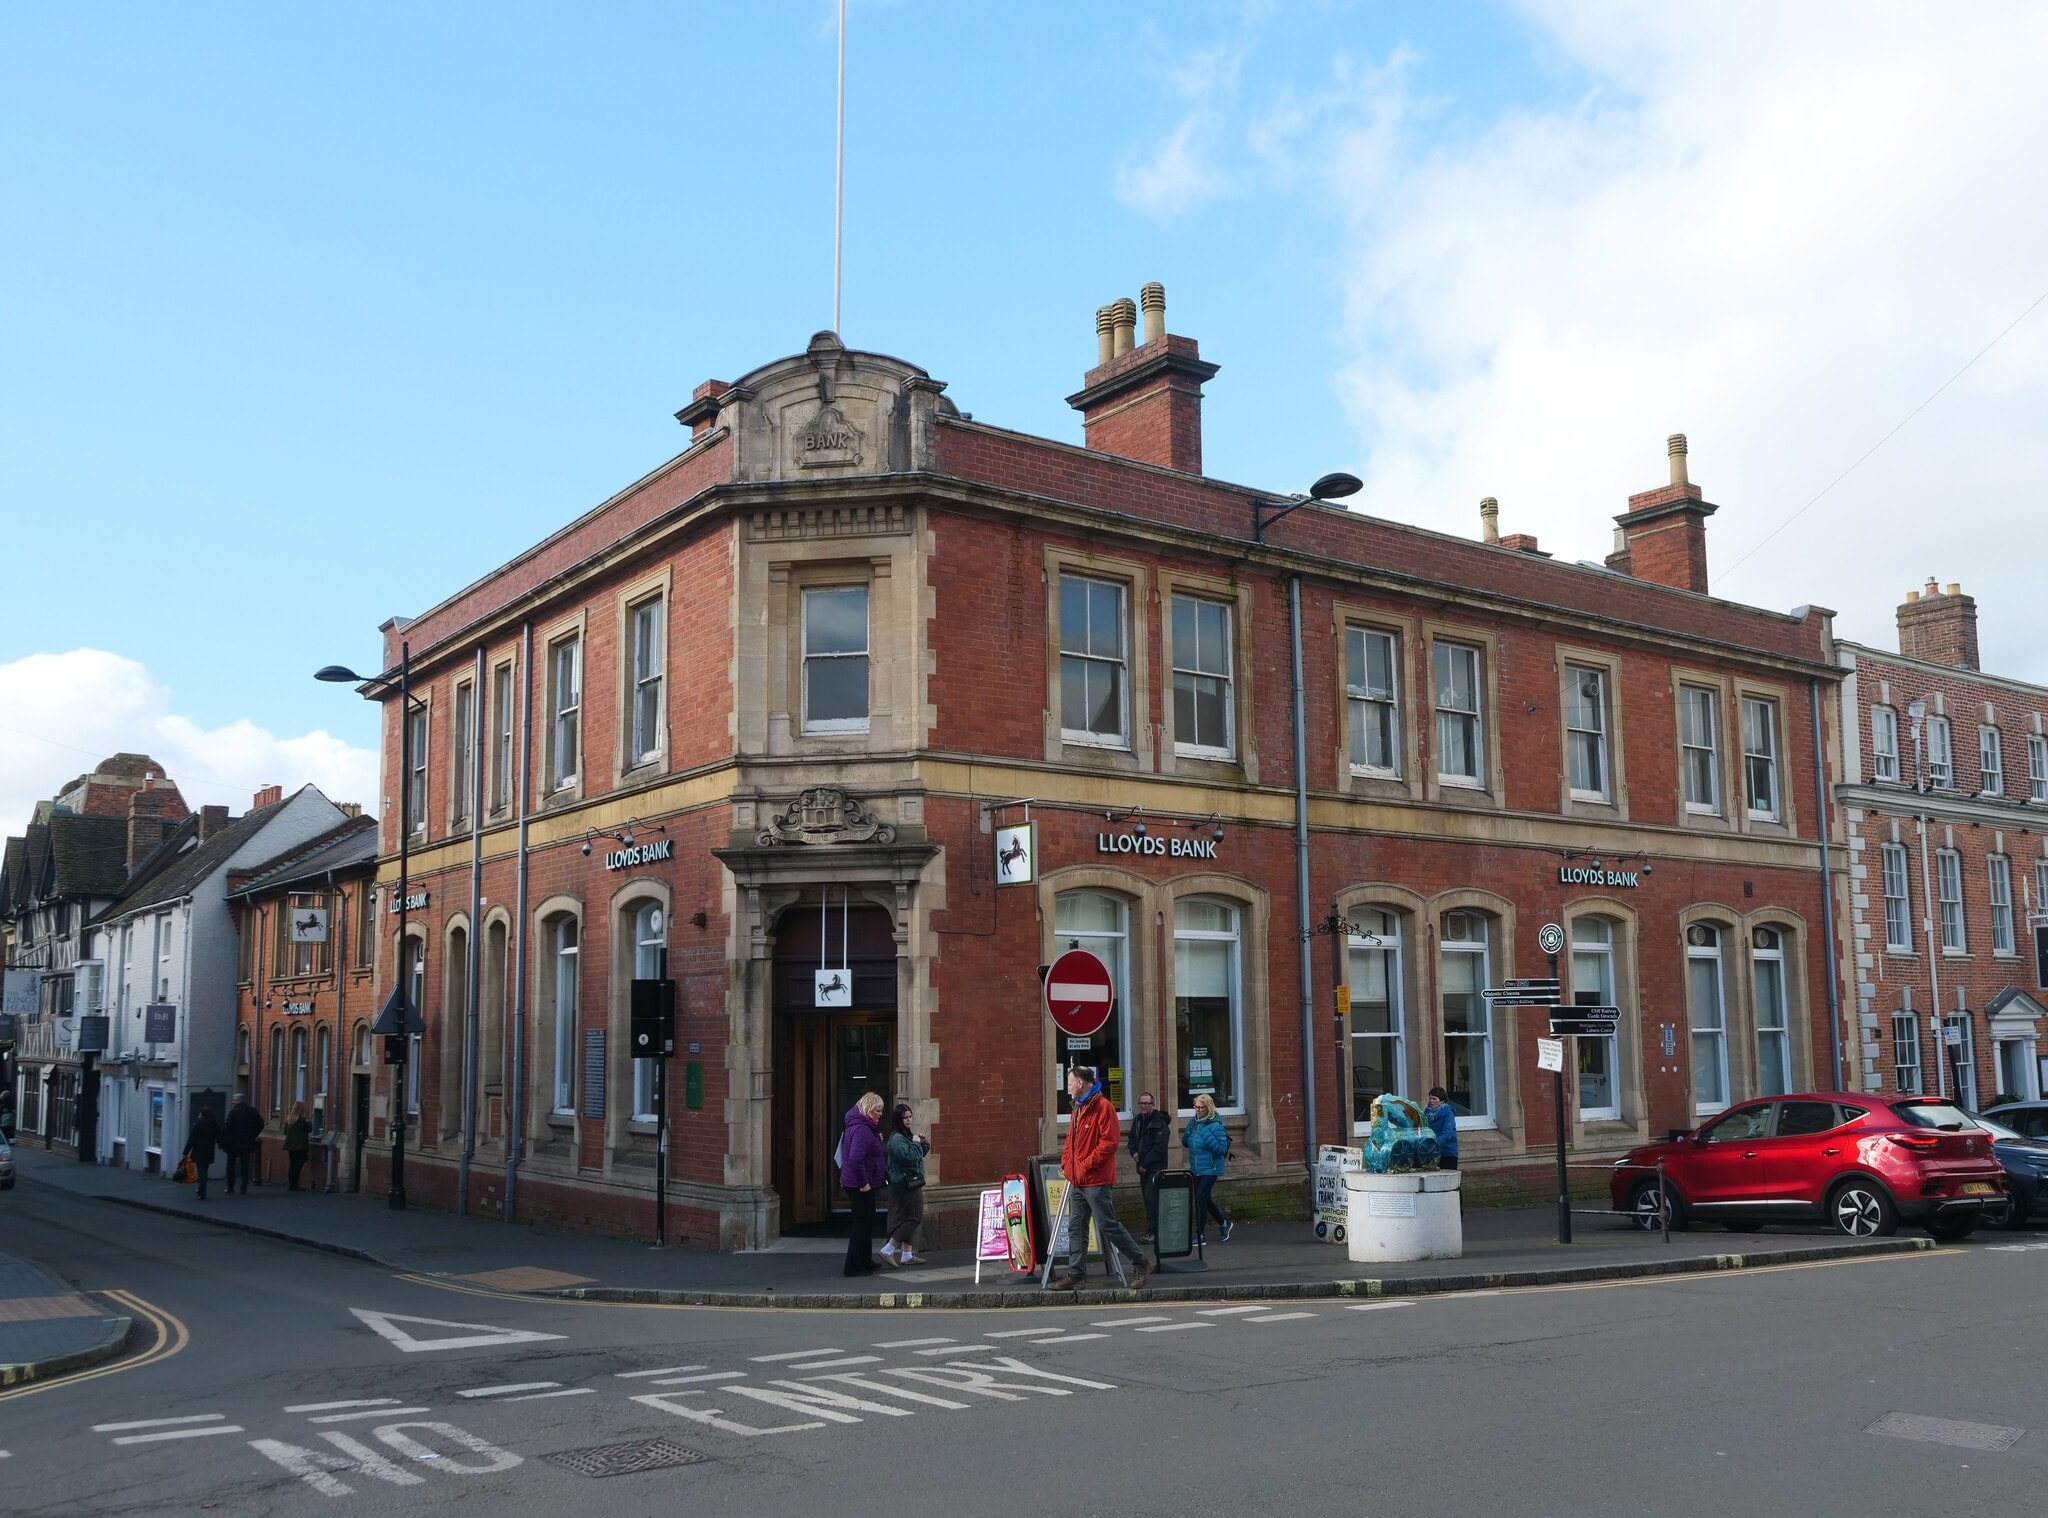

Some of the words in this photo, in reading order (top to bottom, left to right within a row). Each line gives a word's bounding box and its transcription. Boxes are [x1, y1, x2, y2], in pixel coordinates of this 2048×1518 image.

[805, 433, 849, 450] BANK
[605, 847, 641, 870] LLOYDS
[642, 839, 670, 862] BANK
[1100, 832, 1165, 856] LLOYDS
[1171, 838, 1217, 858] BANK
[1561, 867, 1605, 884] LLOYDS
[1607, 870, 1639, 887] BANK
[389, 896, 410, 913] LLOS
[411, 892, 427, 909] BANK
[299, 1002, 312, 1014] BANK
[1320, 1176, 1335, 1189] COINS
[1318, 1191, 1335, 1203] TRAINS
[1321, 1214, 1347, 1225] ANTIQUES
[628, 1357, 1118, 1437] ENTRY
[246, 1421, 525, 1497] NO
